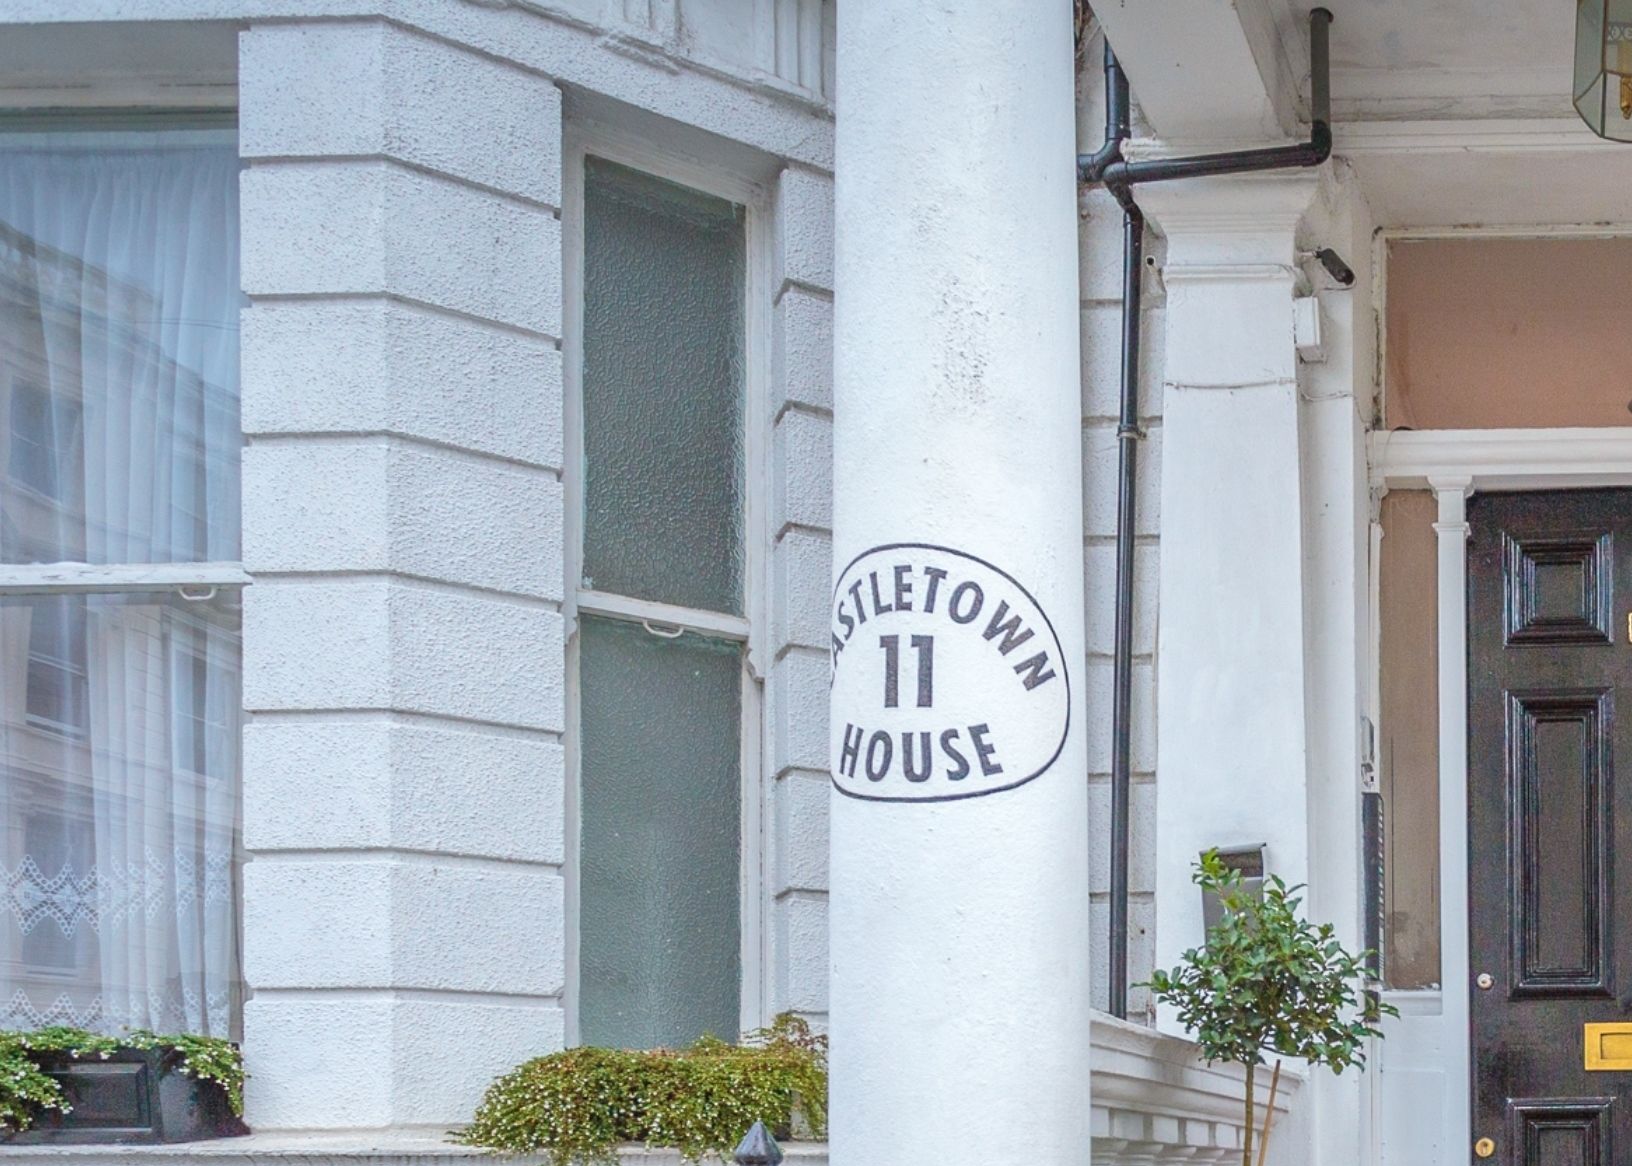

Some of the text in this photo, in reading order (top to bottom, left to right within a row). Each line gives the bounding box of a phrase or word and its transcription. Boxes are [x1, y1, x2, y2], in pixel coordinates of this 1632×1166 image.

[831, 564, 1056, 691] ASTLETOWN
[879, 634, 934, 708] 11
[839, 723, 1004, 783] HOUSE
